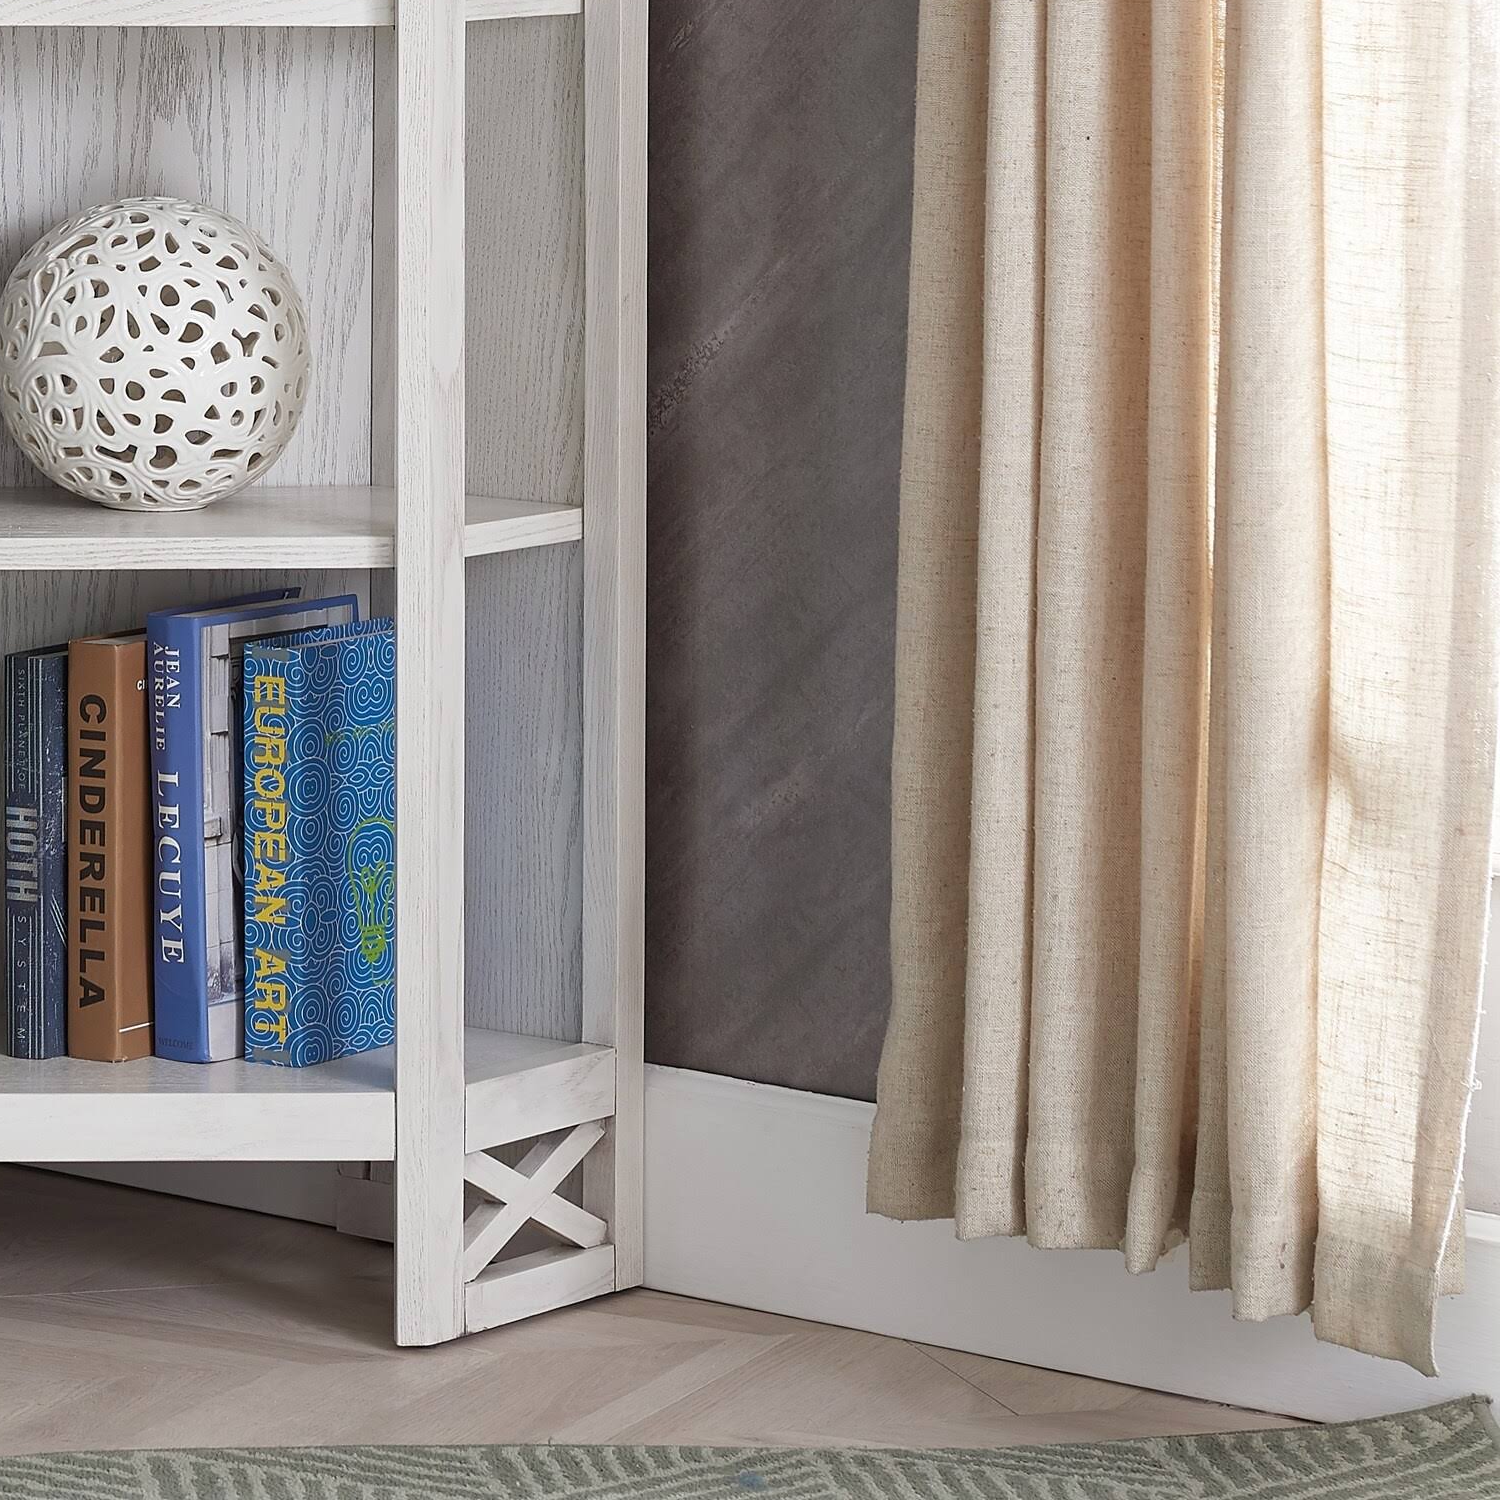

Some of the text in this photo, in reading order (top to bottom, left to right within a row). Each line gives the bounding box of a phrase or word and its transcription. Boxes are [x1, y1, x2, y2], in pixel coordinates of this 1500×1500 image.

[18, 669, 26, 708] SIXTH
[154, 642, 166, 750] AURELIE
[164, 646, 180, 709] JEAN
[6, 806, 38, 902] HOTH
[79, 694, 108, 1009] CINDERELLA
[157, 769, 186, 964] LECUYE
[254, 674, 288, 1044] EUROPEAN ART
[16, 916, 27, 1040] SYSTEM
